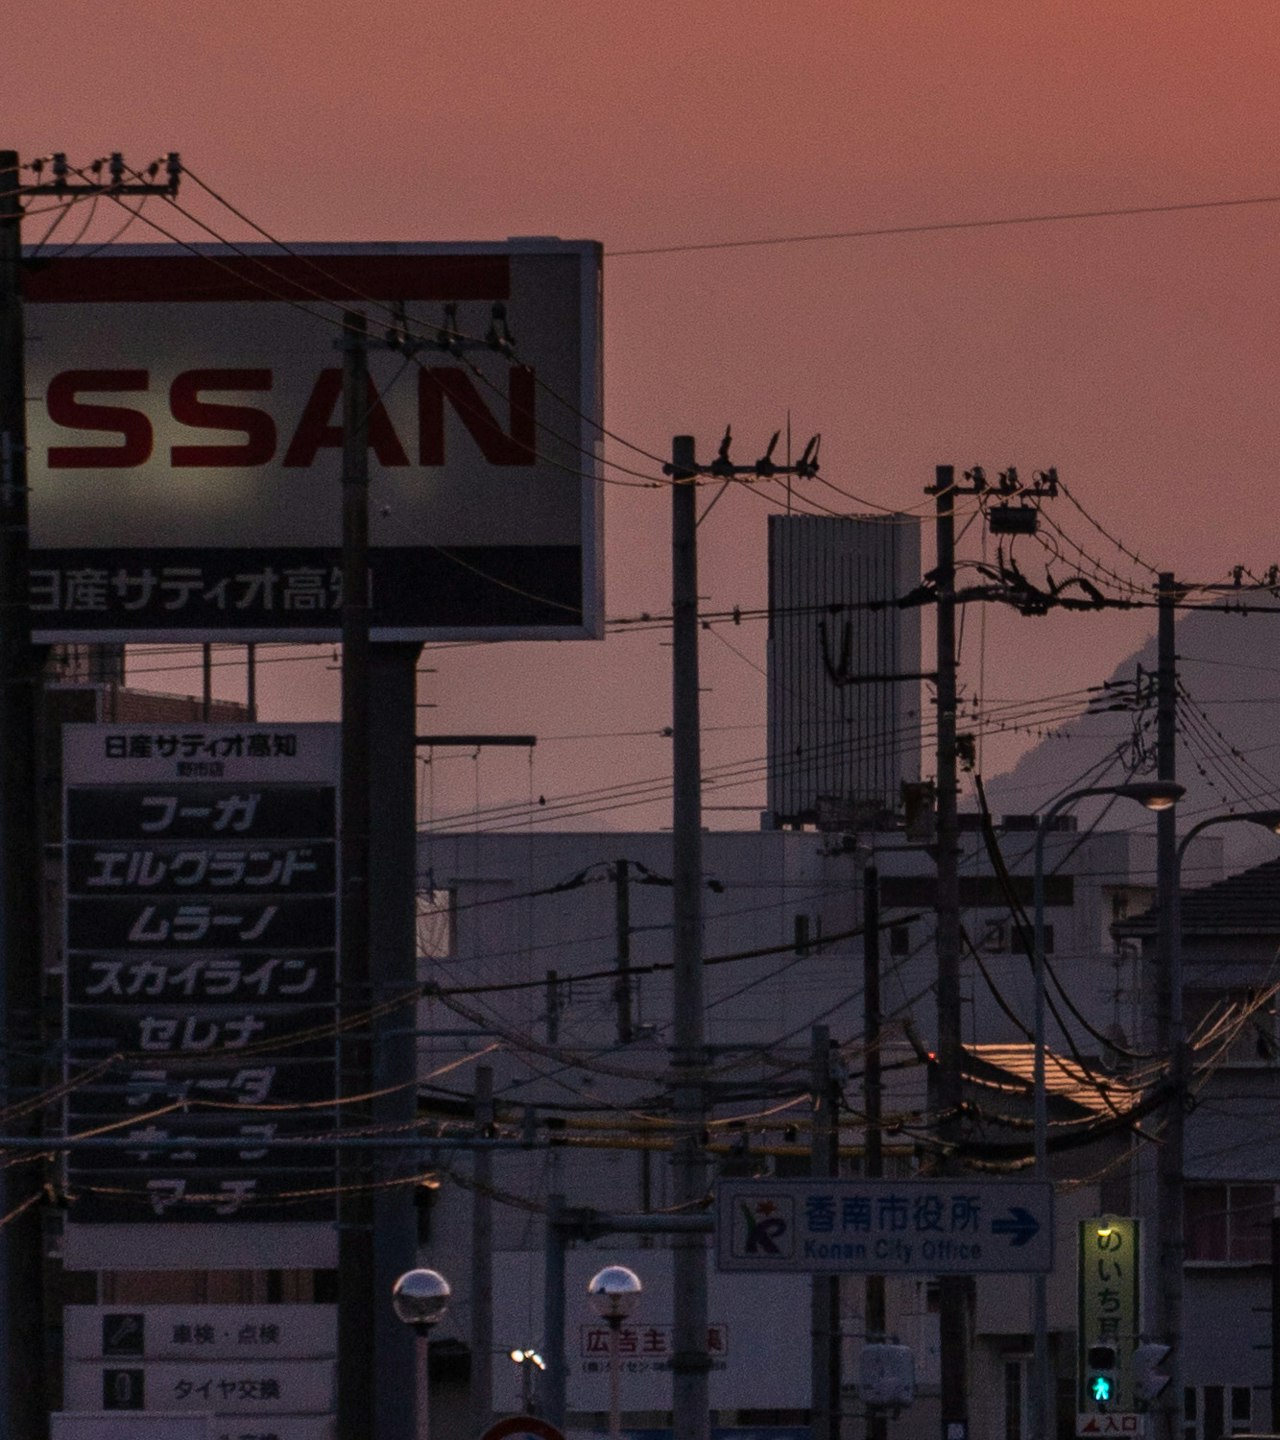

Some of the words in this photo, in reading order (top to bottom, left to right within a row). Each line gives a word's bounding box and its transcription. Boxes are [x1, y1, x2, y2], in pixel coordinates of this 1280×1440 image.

[105, 734, 297, 759] 日産サティオ高知
[141, 794, 262, 832] フーガ
[87, 850, 317, 887] エルグランド
[127, 904, 279, 942] ムラーノ
[85, 959, 318, 996] スカイライン
[138, 1015, 266, 1051] セレナ
[124, 1124, 277, 1161] キュブ
[146, 1179, 257, 1215] マチ
[805, 1194, 983, 1234] 香南市役所
[804, 1239, 866, 1259] Konan
[172, 1323, 280, 1345] 車検・点検
[173, 1378, 281, 1401] タイヤ交換
[1104, 1416, 1137, 1431] 入口
